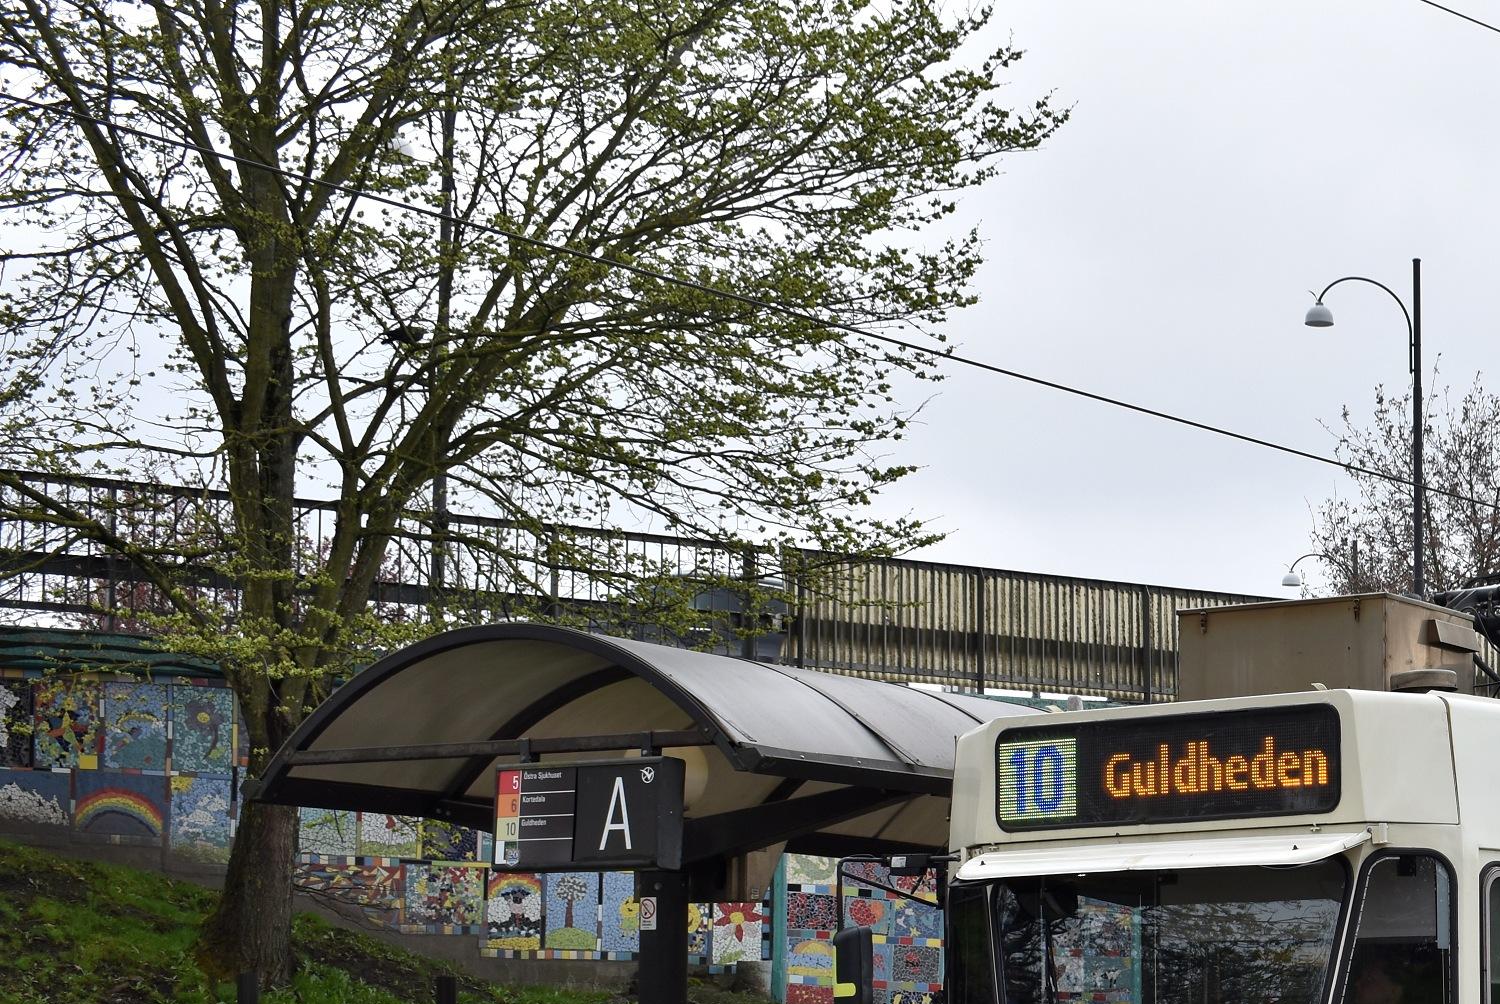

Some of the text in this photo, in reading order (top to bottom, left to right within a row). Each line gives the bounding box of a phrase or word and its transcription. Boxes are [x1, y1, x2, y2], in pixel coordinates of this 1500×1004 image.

[1010, 735, 1328, 813] 10 Guldheden
[512, 775, 519, 790] 5
[511, 799, 517, 813] 6
[599, 776, 632, 851] A
[505, 821, 516, 836] 10
